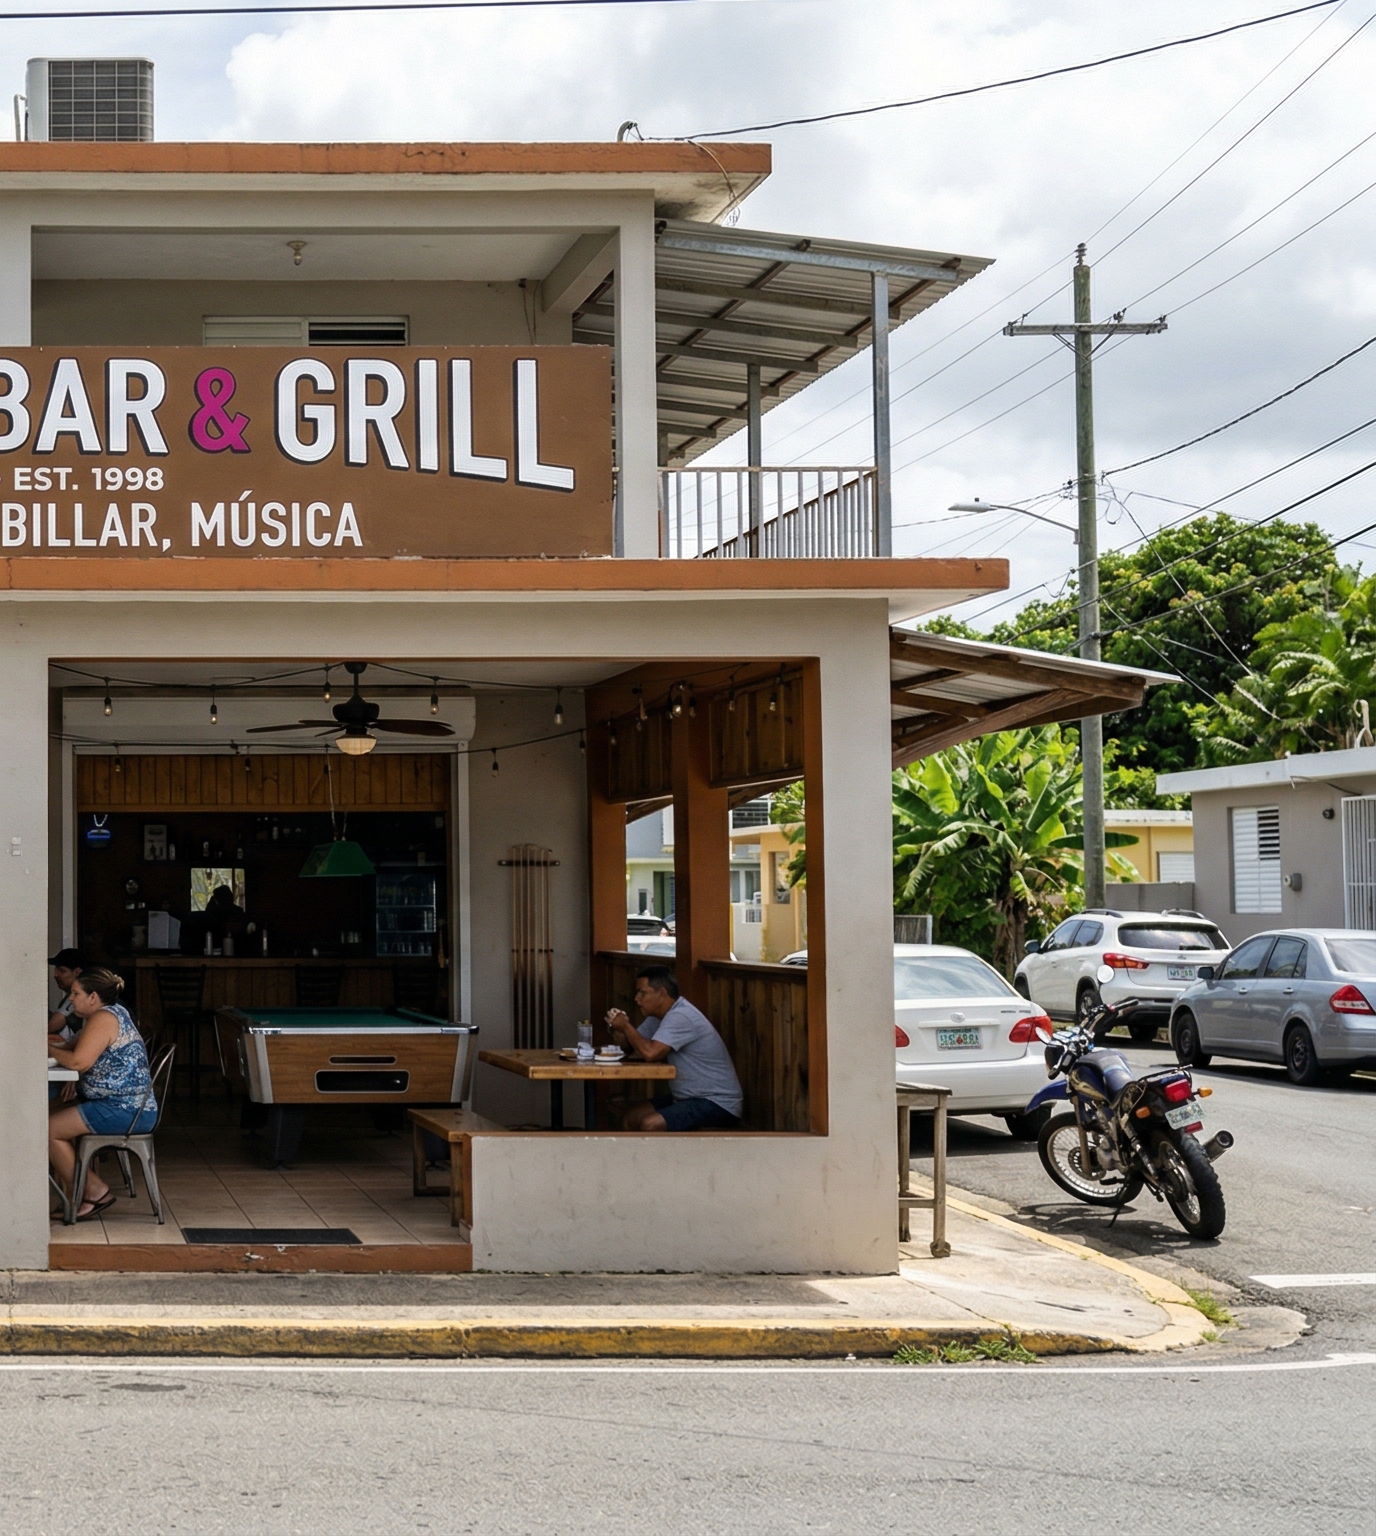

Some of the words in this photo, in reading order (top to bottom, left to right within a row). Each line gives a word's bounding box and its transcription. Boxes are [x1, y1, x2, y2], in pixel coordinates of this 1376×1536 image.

[191, 368, 248, 453] &
[277, 358, 575, 491] GRILL
[14, 466, 79, 492] EST.
[91, 466, 165, 492] 1998
[1, 502, 172, 553] BILLAR,
[190, 489, 364, 548] MÚSICA
